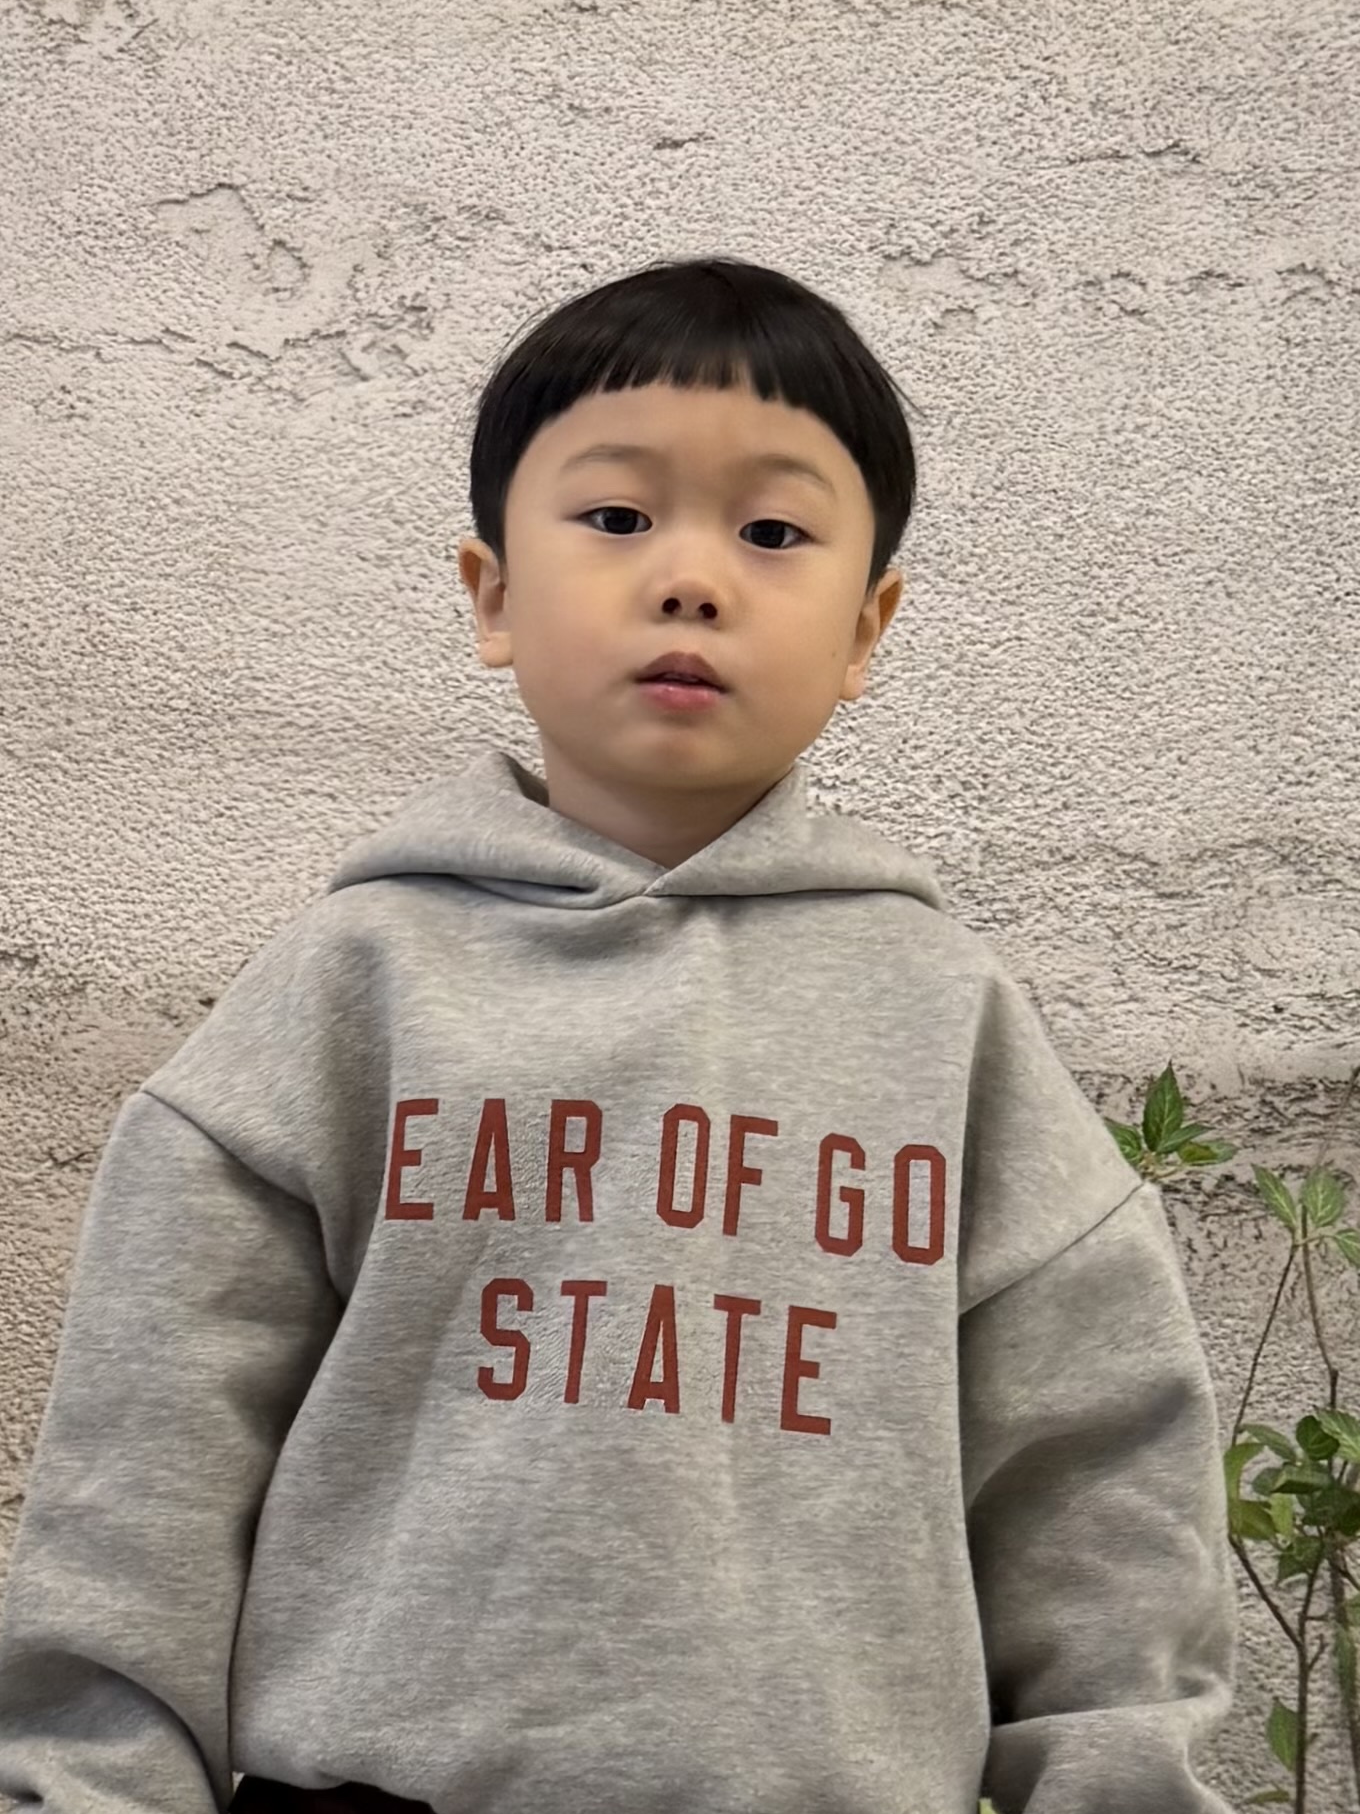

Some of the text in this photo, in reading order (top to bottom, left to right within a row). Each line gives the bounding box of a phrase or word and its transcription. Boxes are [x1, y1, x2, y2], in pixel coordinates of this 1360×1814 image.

[385, 1098, 946, 1265] EAR OF GO
[477, 1278, 837, 1436] STATE
